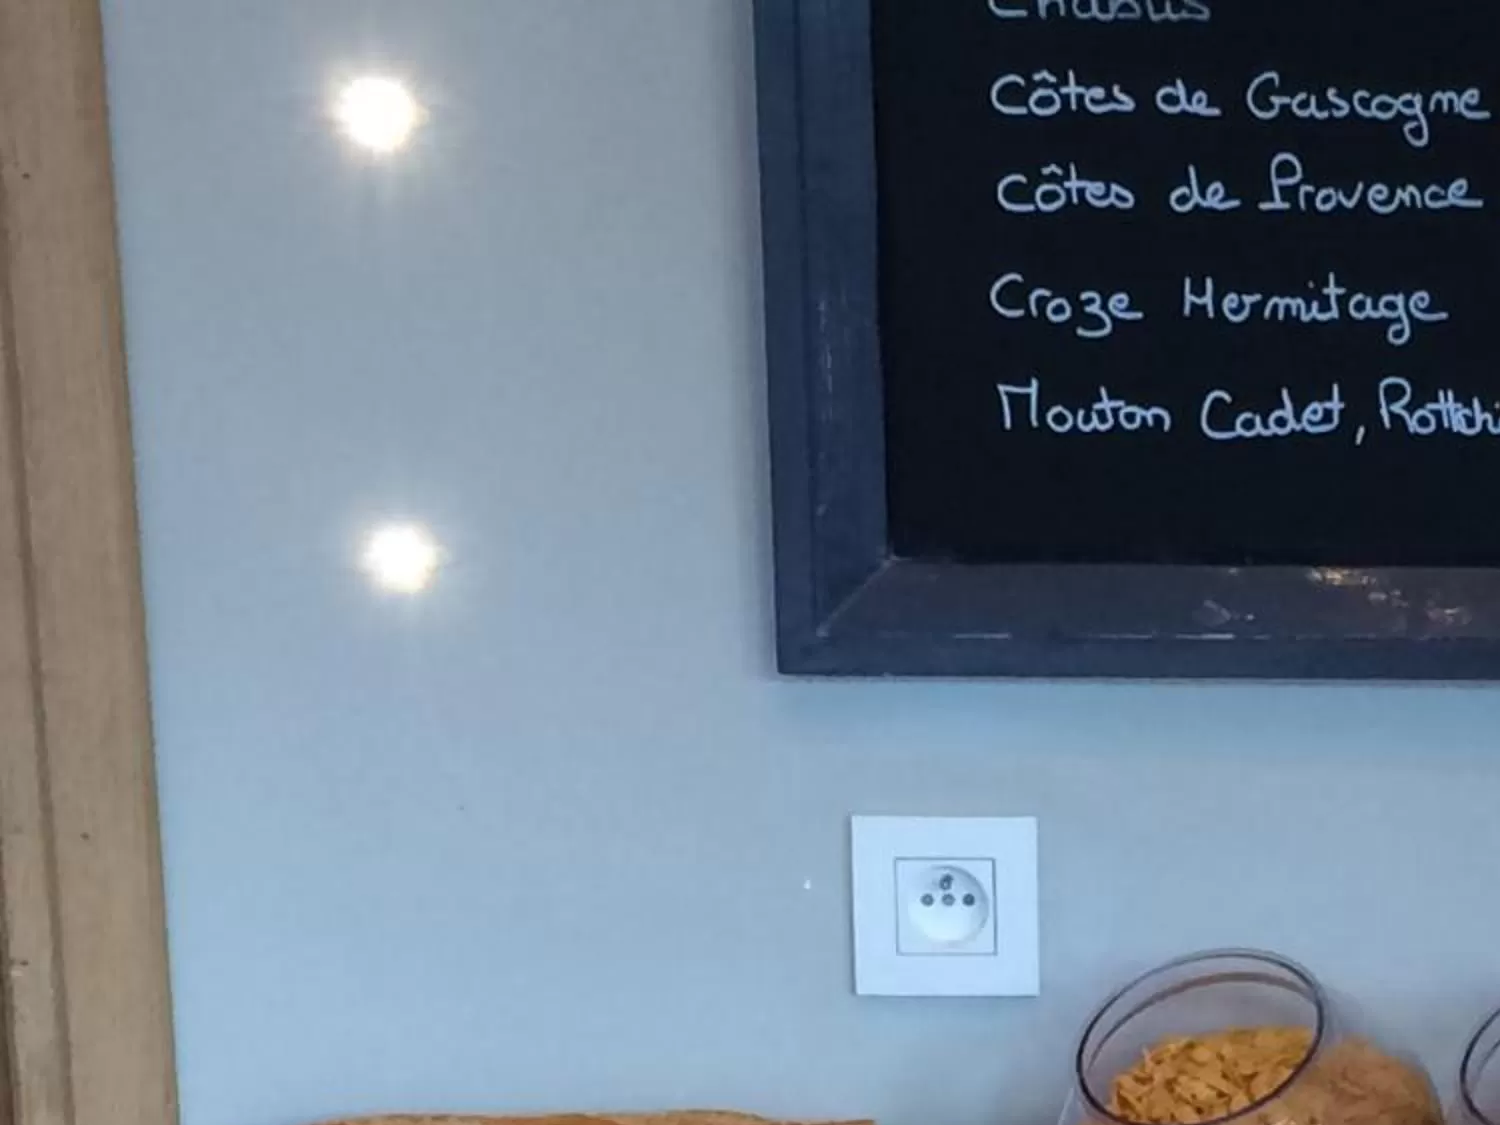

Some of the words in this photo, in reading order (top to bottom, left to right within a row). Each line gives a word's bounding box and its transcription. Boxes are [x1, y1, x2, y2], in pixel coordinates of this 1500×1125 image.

[991, 70, 1136, 119] Côtes
[1156, 77, 1222, 117] de
[1247, 72, 1491, 147] Gascogne
[998, 164, 1136, 212] Côtes
[1170, 166, 1241, 213] de
[1259, 152, 1484, 213] Provence
[990, 273, 1144, 337] Croze
[1184, 272, 1449, 345] Hermitage
[997, 378, 1171, 433] Mouton
